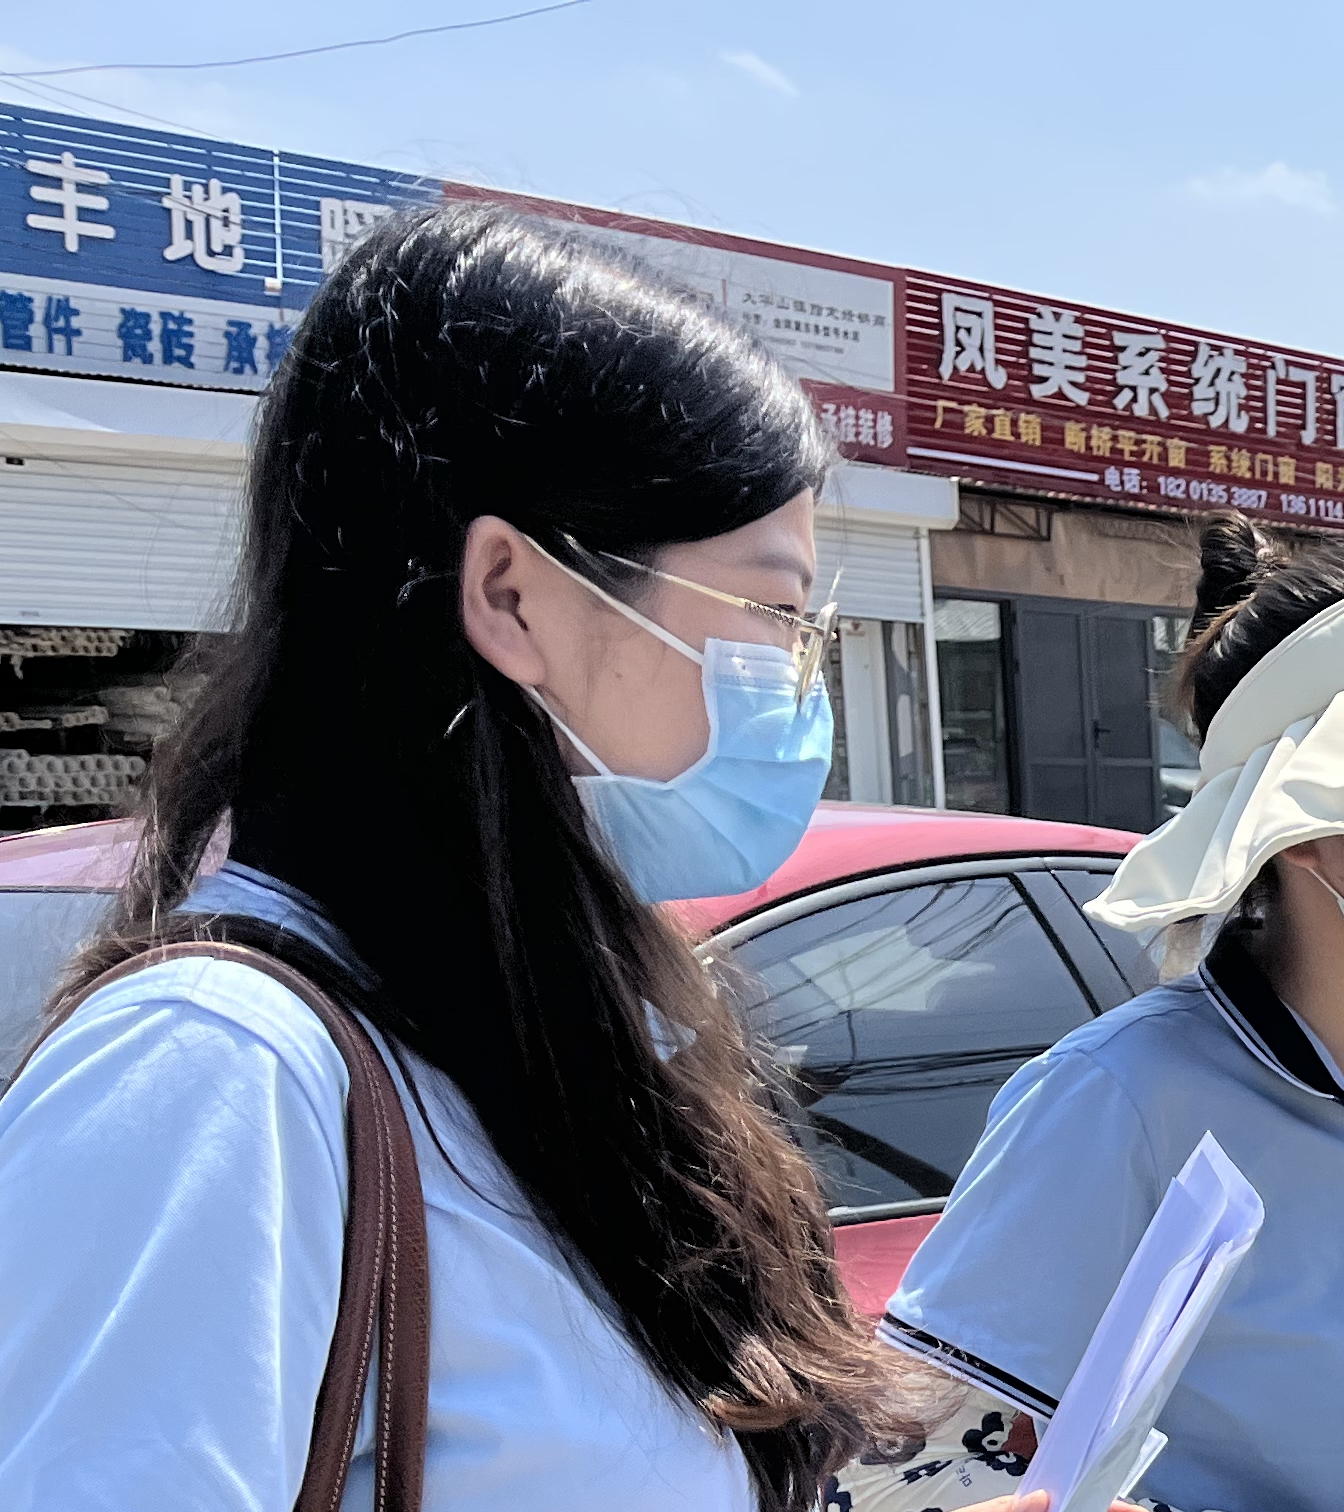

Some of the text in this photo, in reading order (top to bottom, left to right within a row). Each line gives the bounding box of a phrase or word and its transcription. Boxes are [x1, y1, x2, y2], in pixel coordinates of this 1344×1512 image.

[117, 306, 196, 369] 瓷砖
[935, 401, 1042, 446] 厂家直销
[1063, 422, 1187, 470] 断桥平开窗
[1207, 445, 1297, 486] 系统门窗
[1156, 475, 1187, 499] 182
